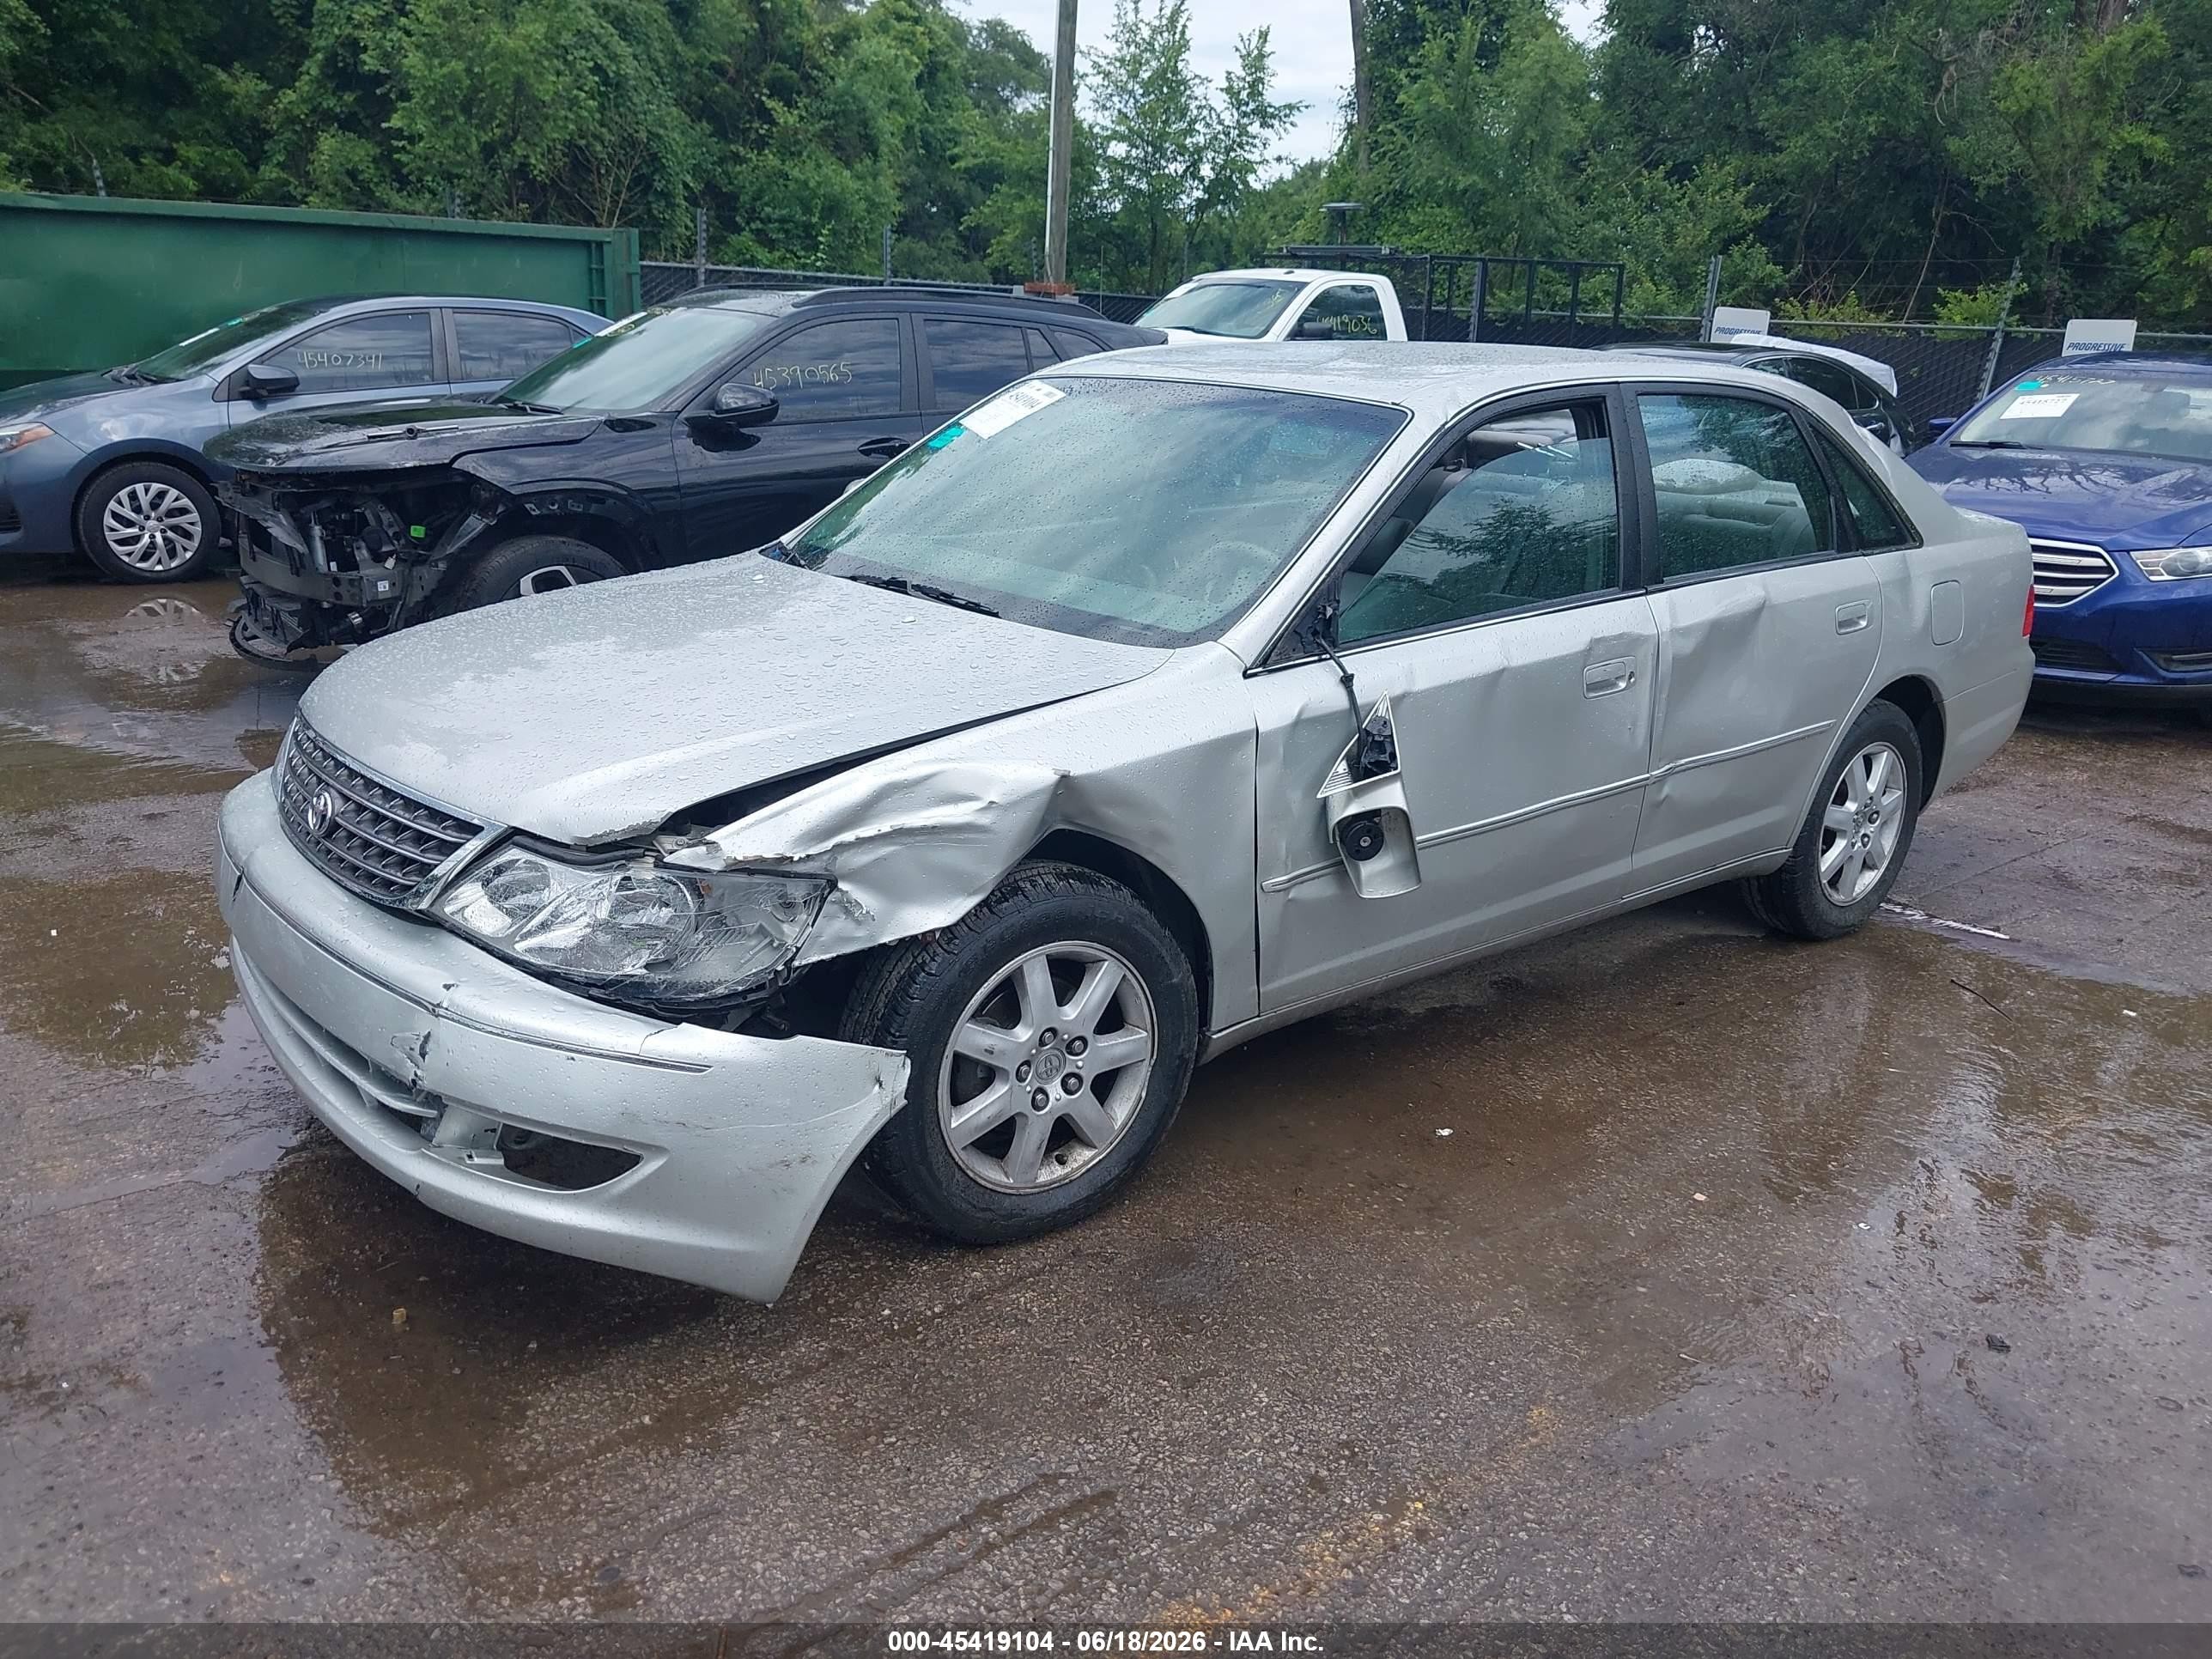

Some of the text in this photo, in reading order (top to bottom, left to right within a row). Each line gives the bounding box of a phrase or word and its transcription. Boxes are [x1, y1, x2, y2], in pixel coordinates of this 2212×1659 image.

[2066, 343, 2126, 351] PROGRESSIVE
[297, 351, 382, 371] 45407341
[754, 362, 853, 390] 45390565
